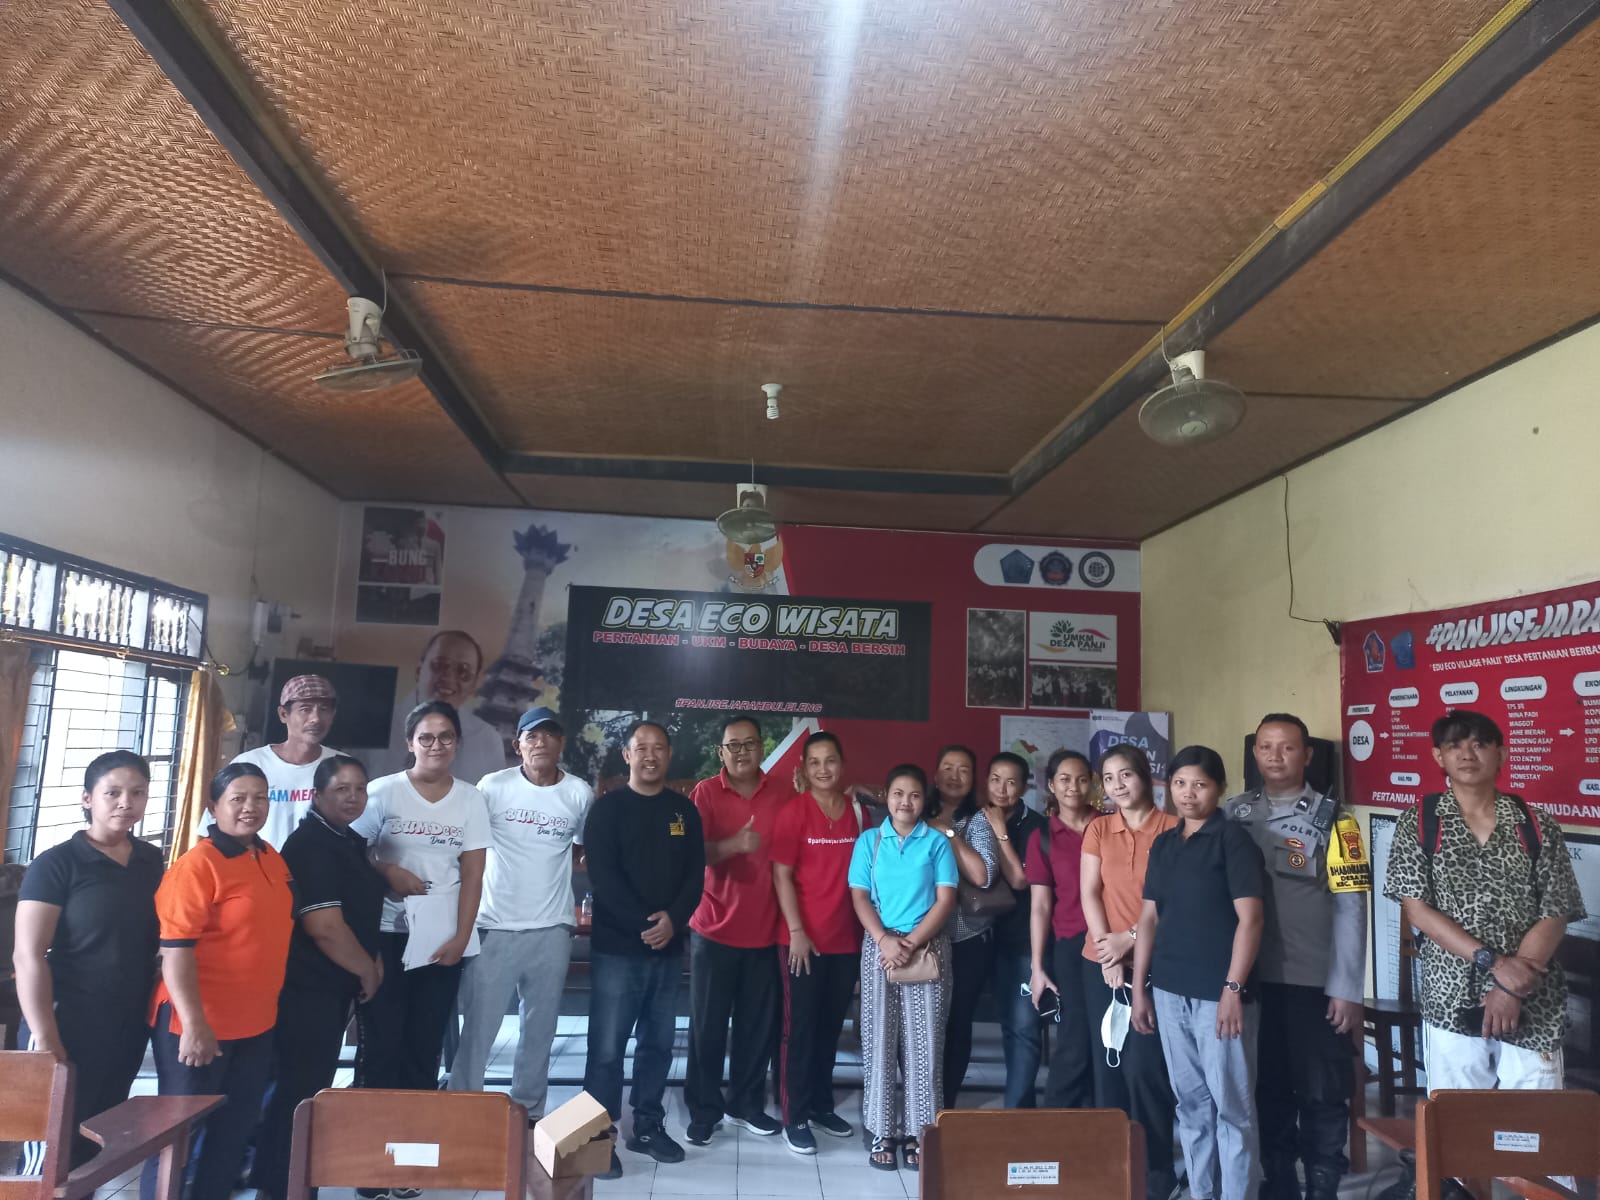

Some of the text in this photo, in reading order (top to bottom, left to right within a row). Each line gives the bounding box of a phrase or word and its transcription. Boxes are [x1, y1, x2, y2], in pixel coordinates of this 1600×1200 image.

[388, 549, 427, 566] BUNG
[602, 596, 899, 640] DESA ECO WISATA
[593, 631, 679, 646] PERTANIAN
[691, 636, 726, 648] UKM
[738, 638, 797, 650] BUDAYA
[809, 641, 848, 653] DESA
[851, 643, 905, 655] BERSIH
[1050, 640, 1105, 649] DESA PANJI
[1504, 655, 1524, 664] DESA
[1523, 648, 1569, 661] PERTANIAN
[1107, 736, 1149, 748] DESA
[1352, 735, 1370, 746] DESA
[1372, 792, 1416, 804] PERTANIAN
[1281, 824, 1318, 838] POLRI
